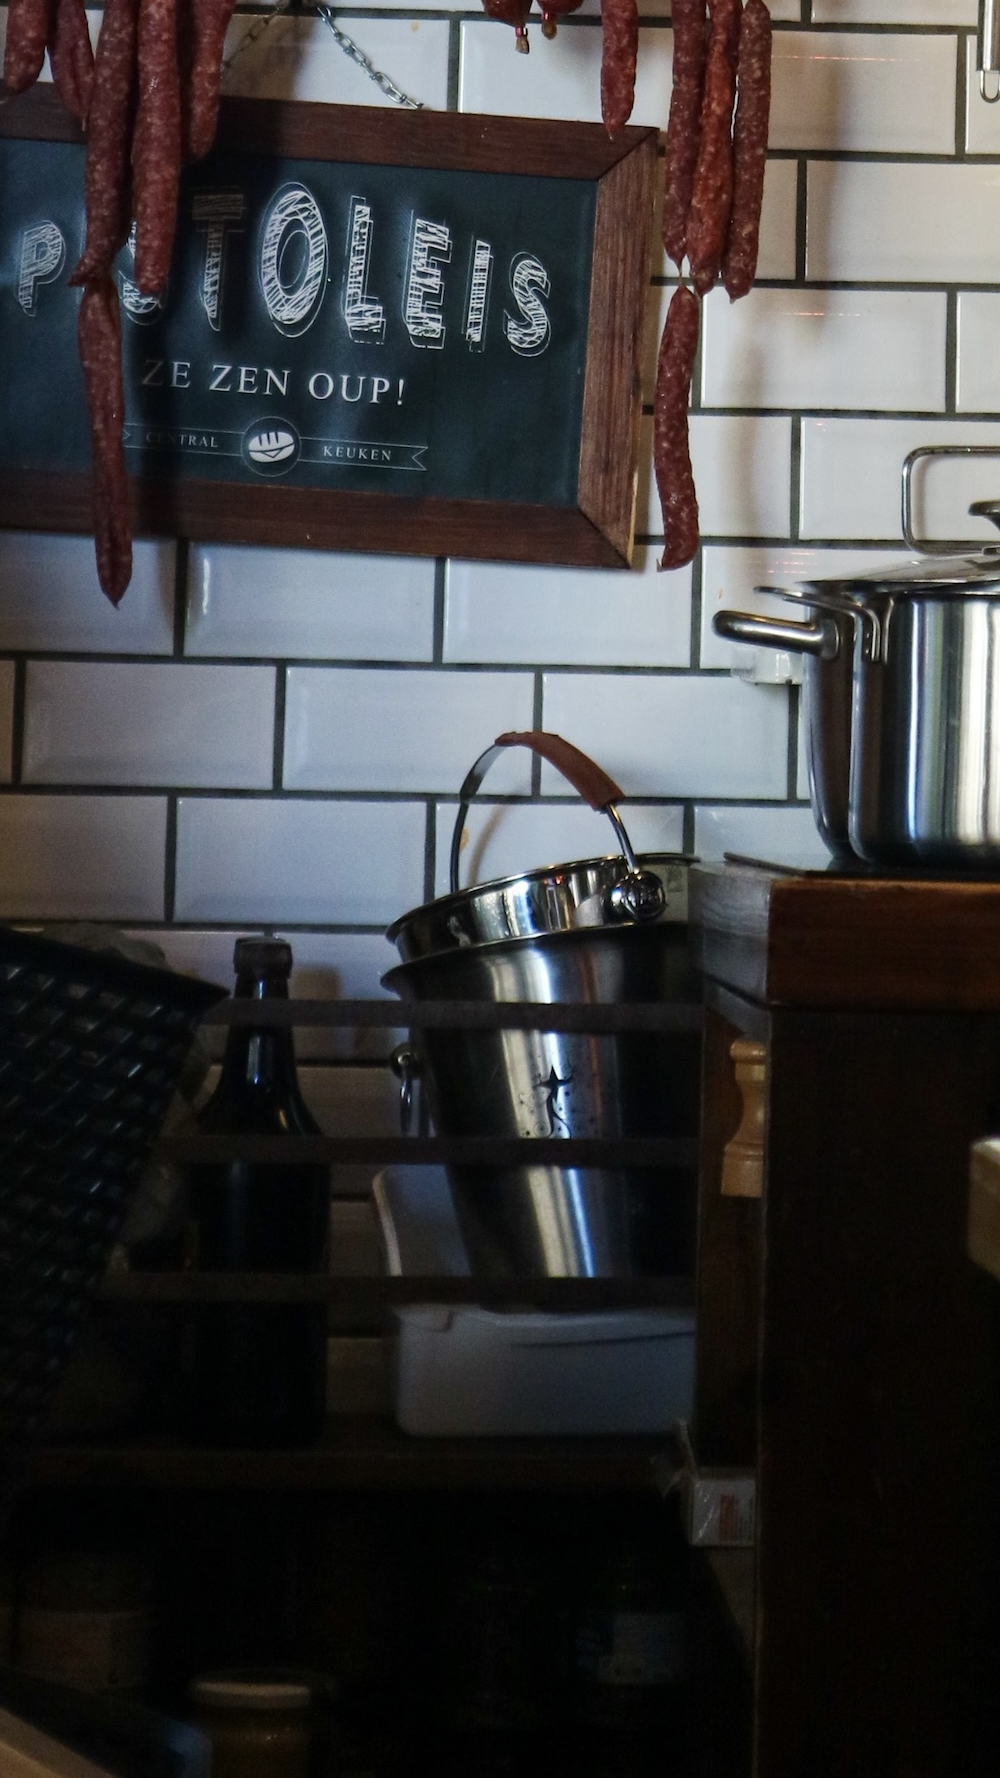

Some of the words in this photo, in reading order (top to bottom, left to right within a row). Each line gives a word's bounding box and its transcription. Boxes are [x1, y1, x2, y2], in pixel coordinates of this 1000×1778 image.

[142, 359, 191, 389] ZE
[208, 364, 291, 396] ZEN
[308, 372, 405, 406] OUP!
[323, 445, 392, 461] KEUKEN
